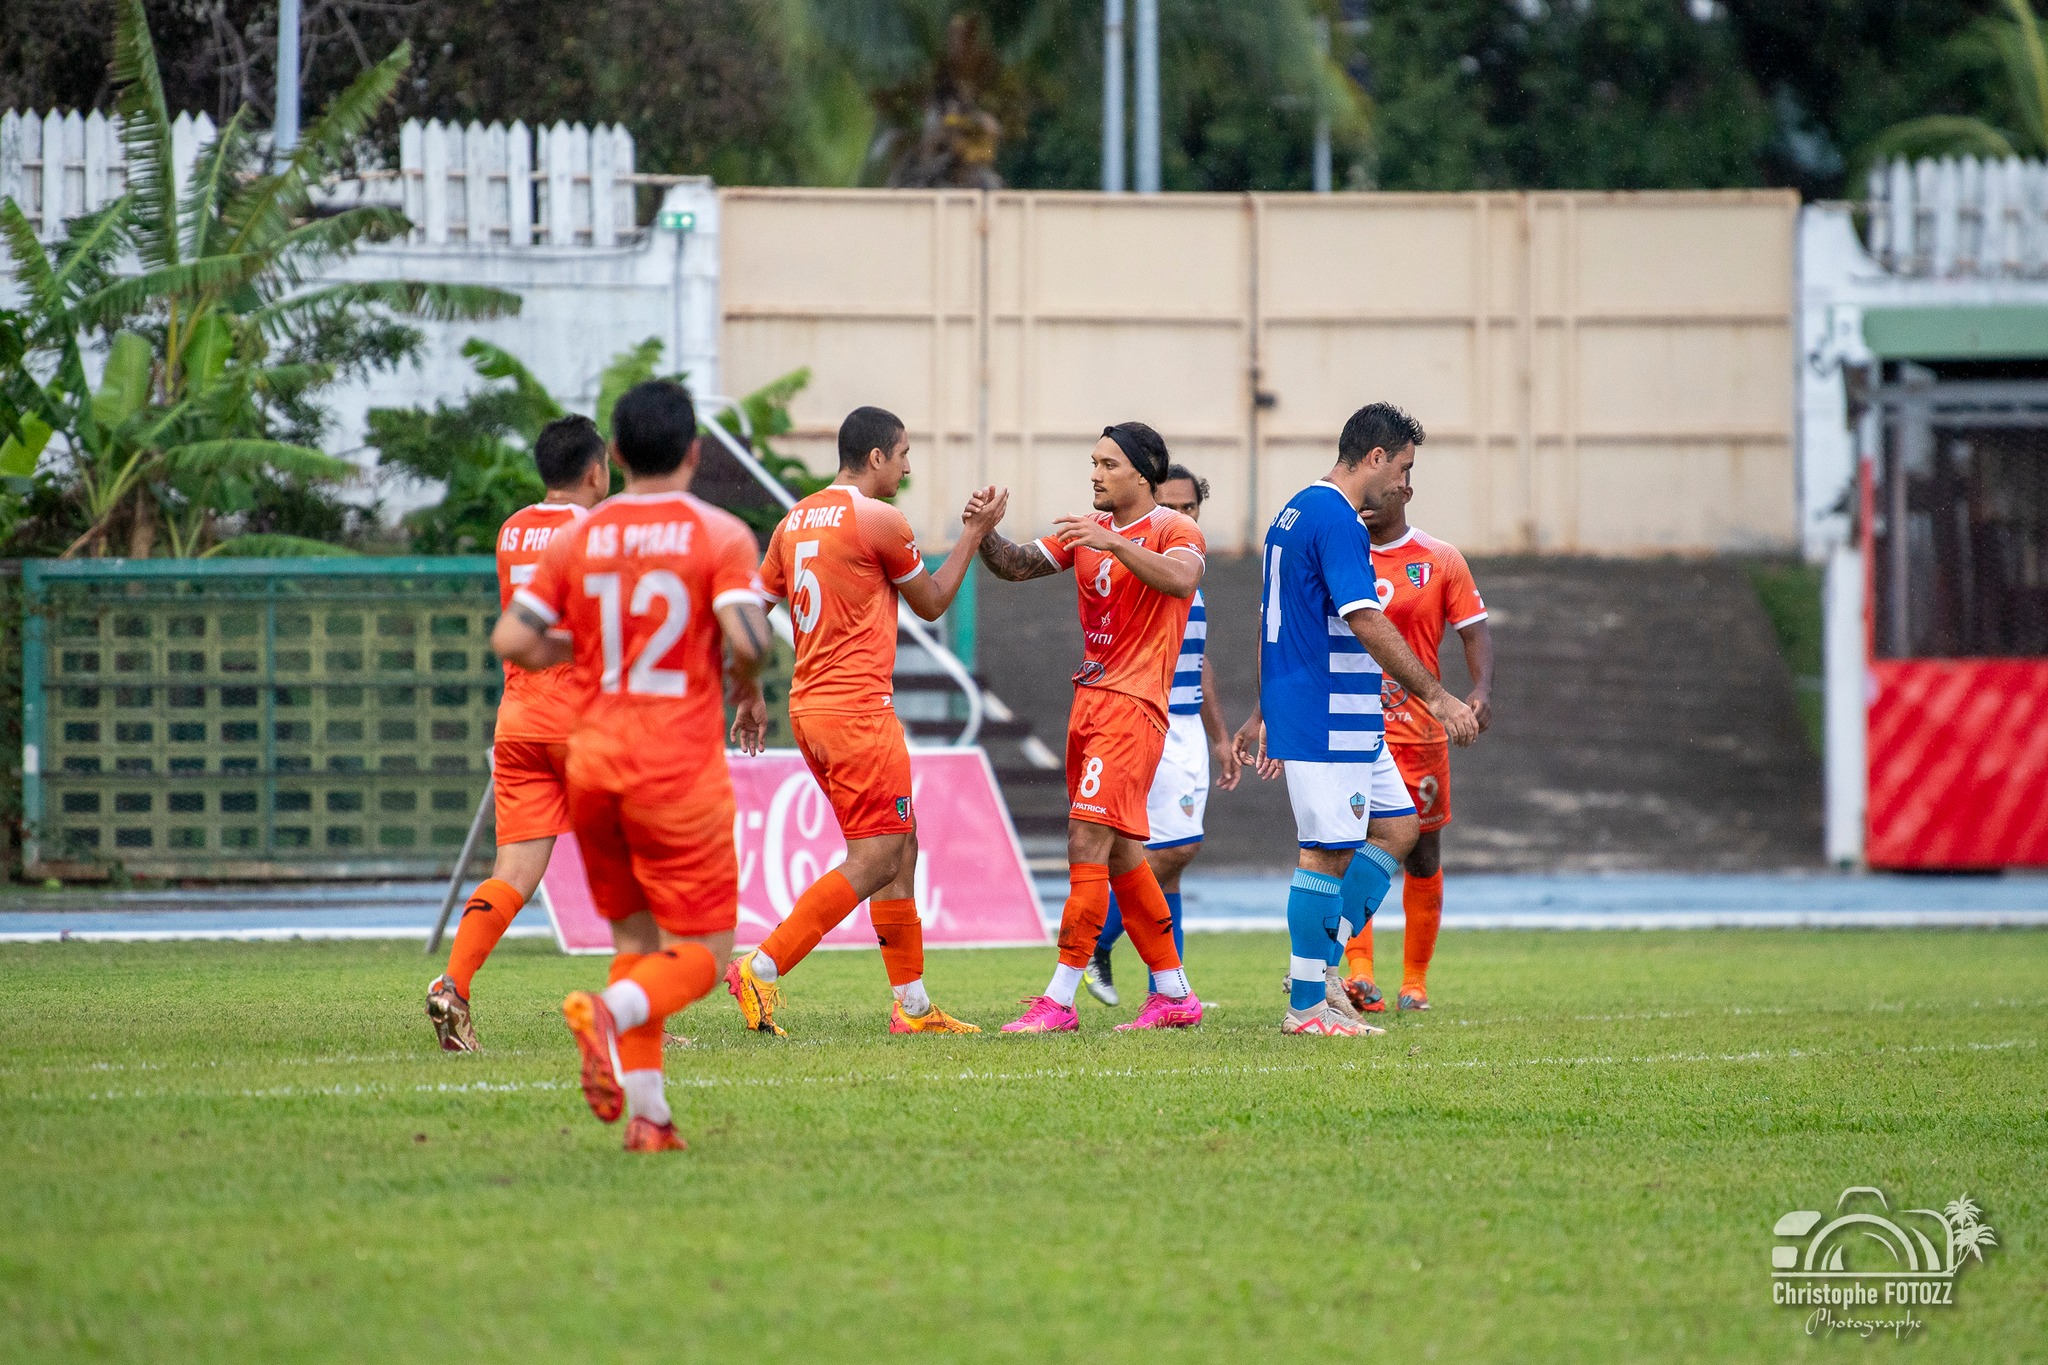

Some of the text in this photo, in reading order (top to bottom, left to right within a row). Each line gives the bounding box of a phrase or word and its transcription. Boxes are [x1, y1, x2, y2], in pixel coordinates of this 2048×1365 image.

[784, 505, 847, 532] AS PIRAE
[500, 526, 561, 552] AS PIR
[585, 521, 695, 560] AS PIRAE
[793, 539, 822, 634] 5
[583, 569, 690, 697] 12
[1384, 711, 1414, 722] OTA
[1080, 756, 1104, 799] 8
[1419, 775, 1438, 814] 9
[1076, 802, 1107, 815] PATRICK
